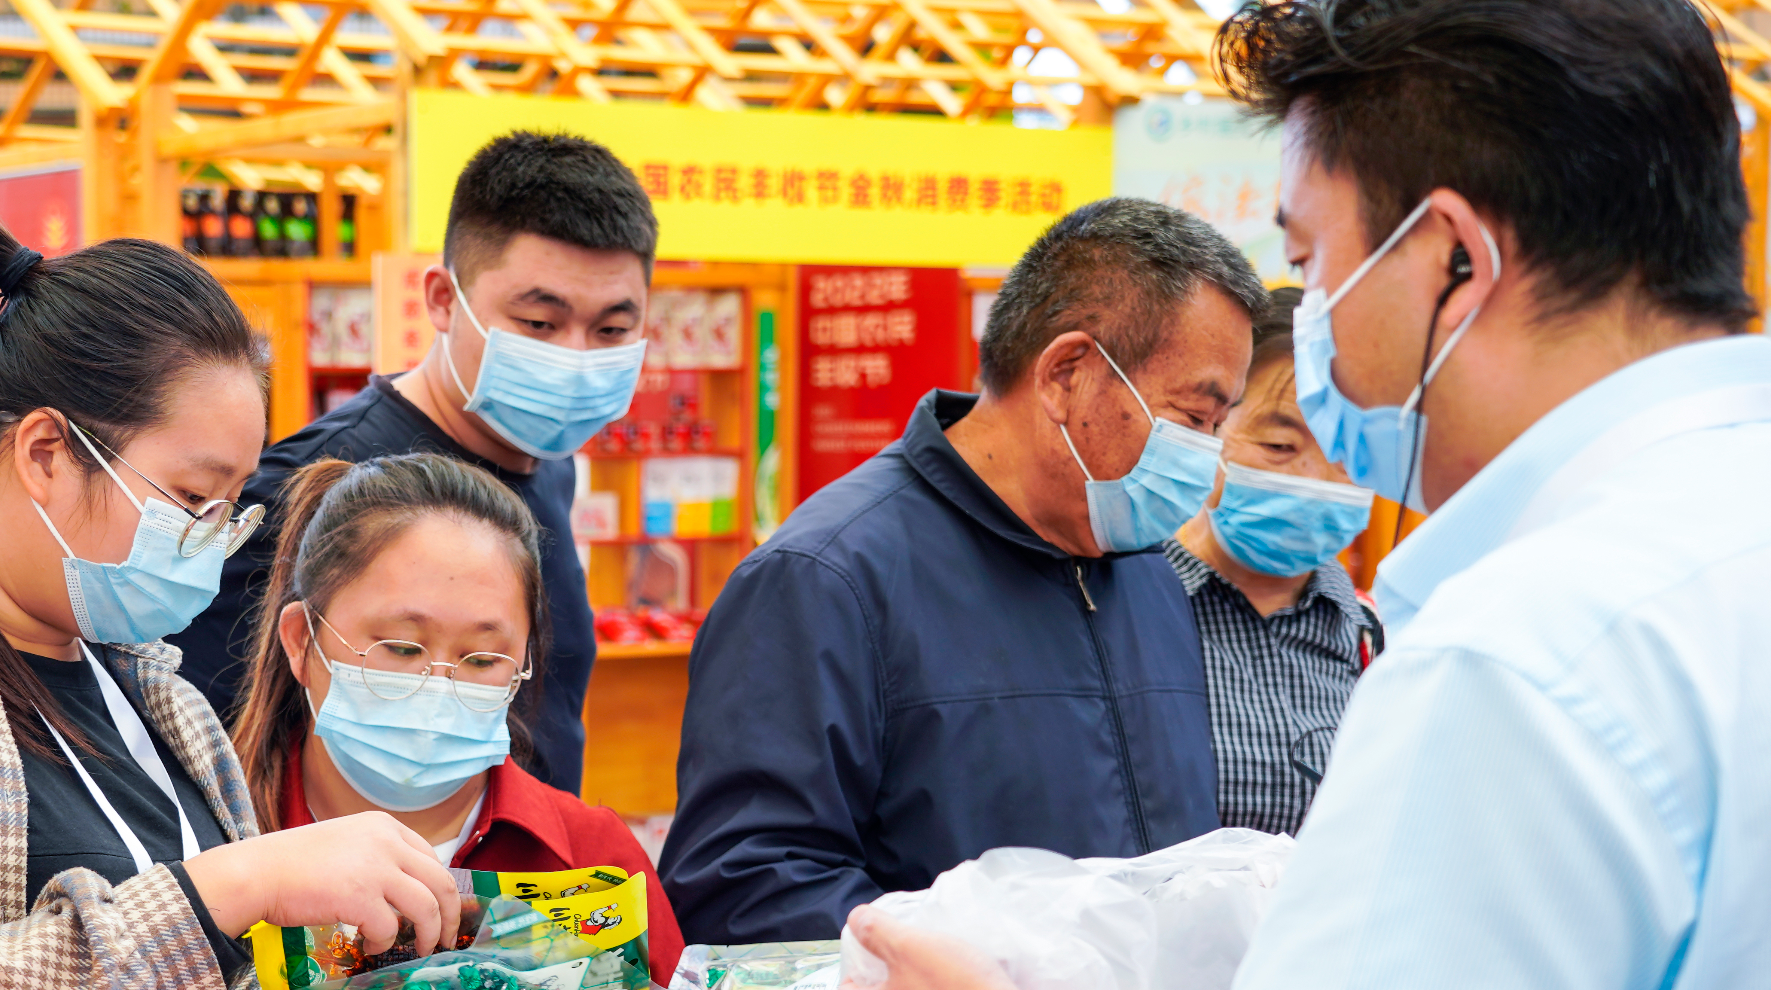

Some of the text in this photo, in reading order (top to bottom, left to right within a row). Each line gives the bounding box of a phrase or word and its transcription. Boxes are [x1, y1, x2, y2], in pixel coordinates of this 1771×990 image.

[640, 161, 1063, 214] 国农民丰收节金秋消费季活动
